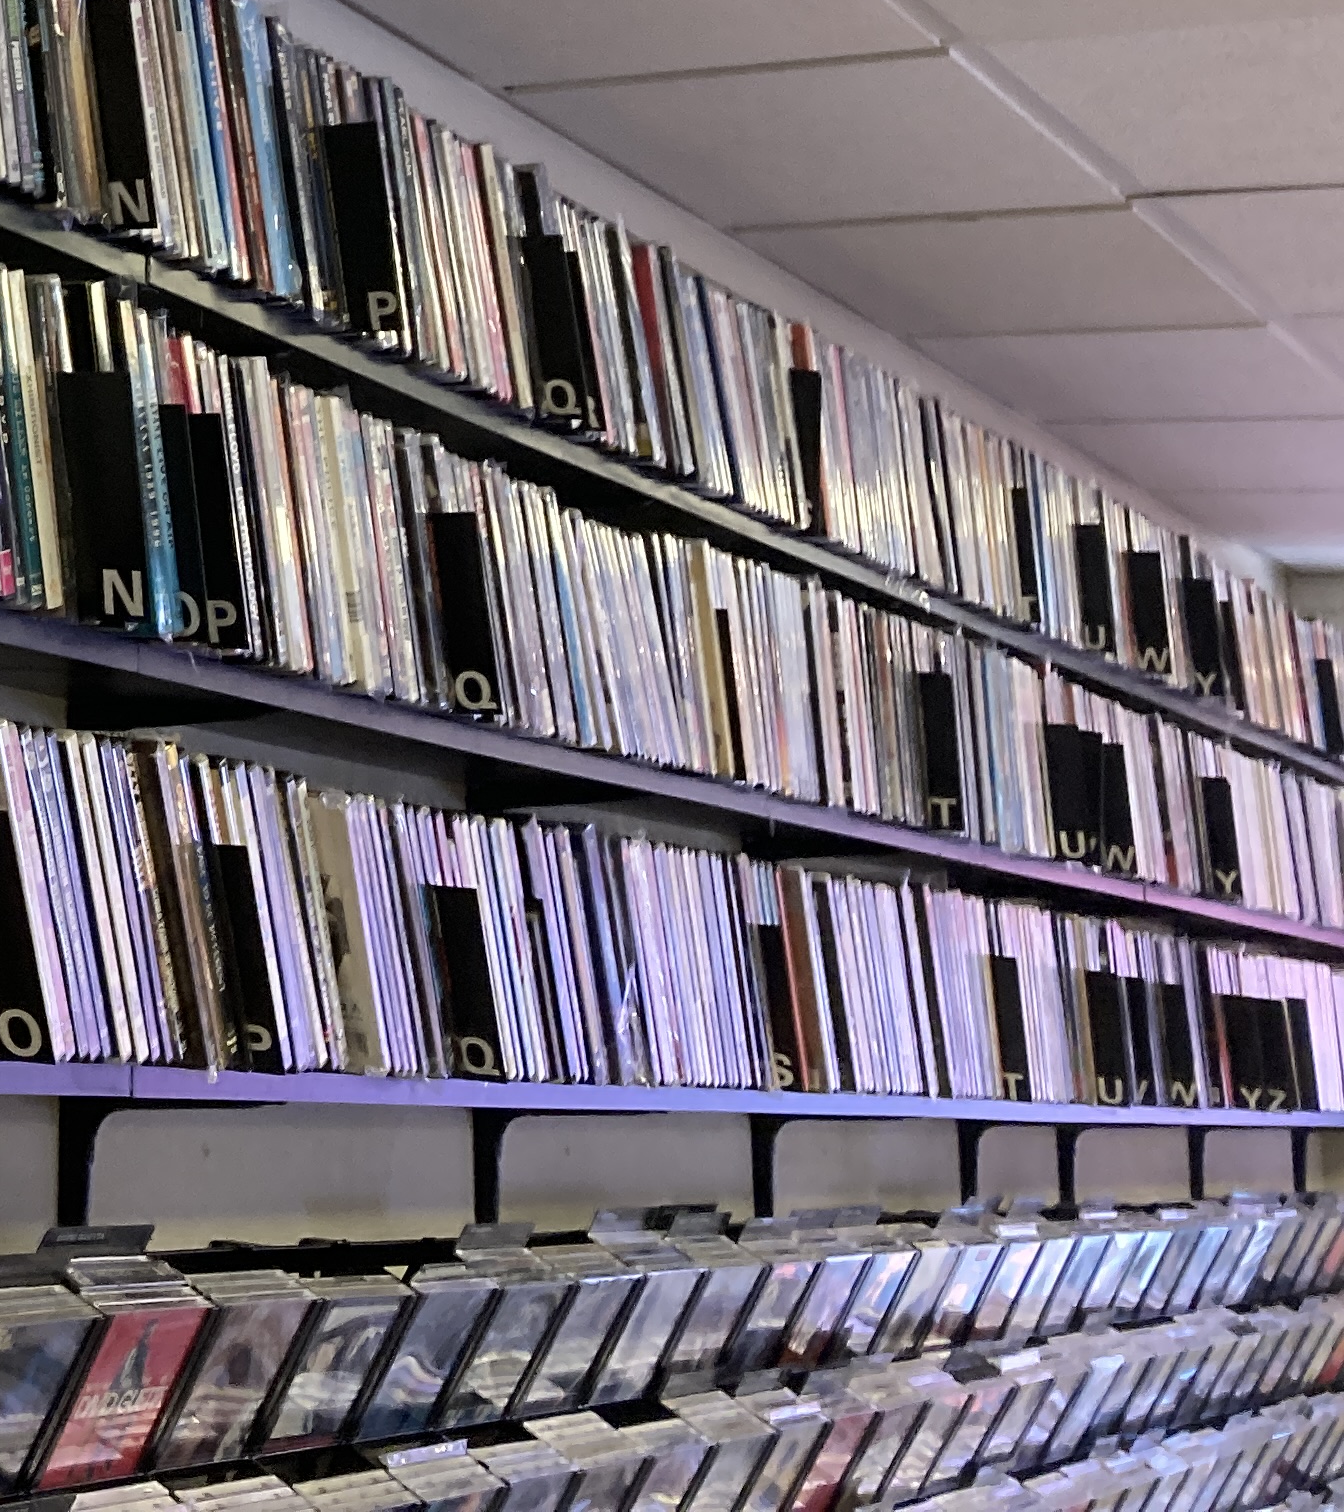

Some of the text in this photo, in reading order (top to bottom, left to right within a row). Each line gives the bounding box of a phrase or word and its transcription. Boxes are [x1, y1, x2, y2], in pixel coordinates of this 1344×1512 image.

[108, 177, 148, 226] N
[367, 290, 399, 331] P
[544, 379, 581, 417] Q
[102, 568, 144, 617] N
[207, 599, 238, 642] P
[454, 671, 496, 711] Q
[931, 797, 957, 826] T
[1058, 831, 1086, 858] U
[1216, 870, 1241, 894] Y
[459, 1038, 501, 1076] Q
[770, 1053, 793, 1084] S
[1097, 1076, 1124, 1104] U
